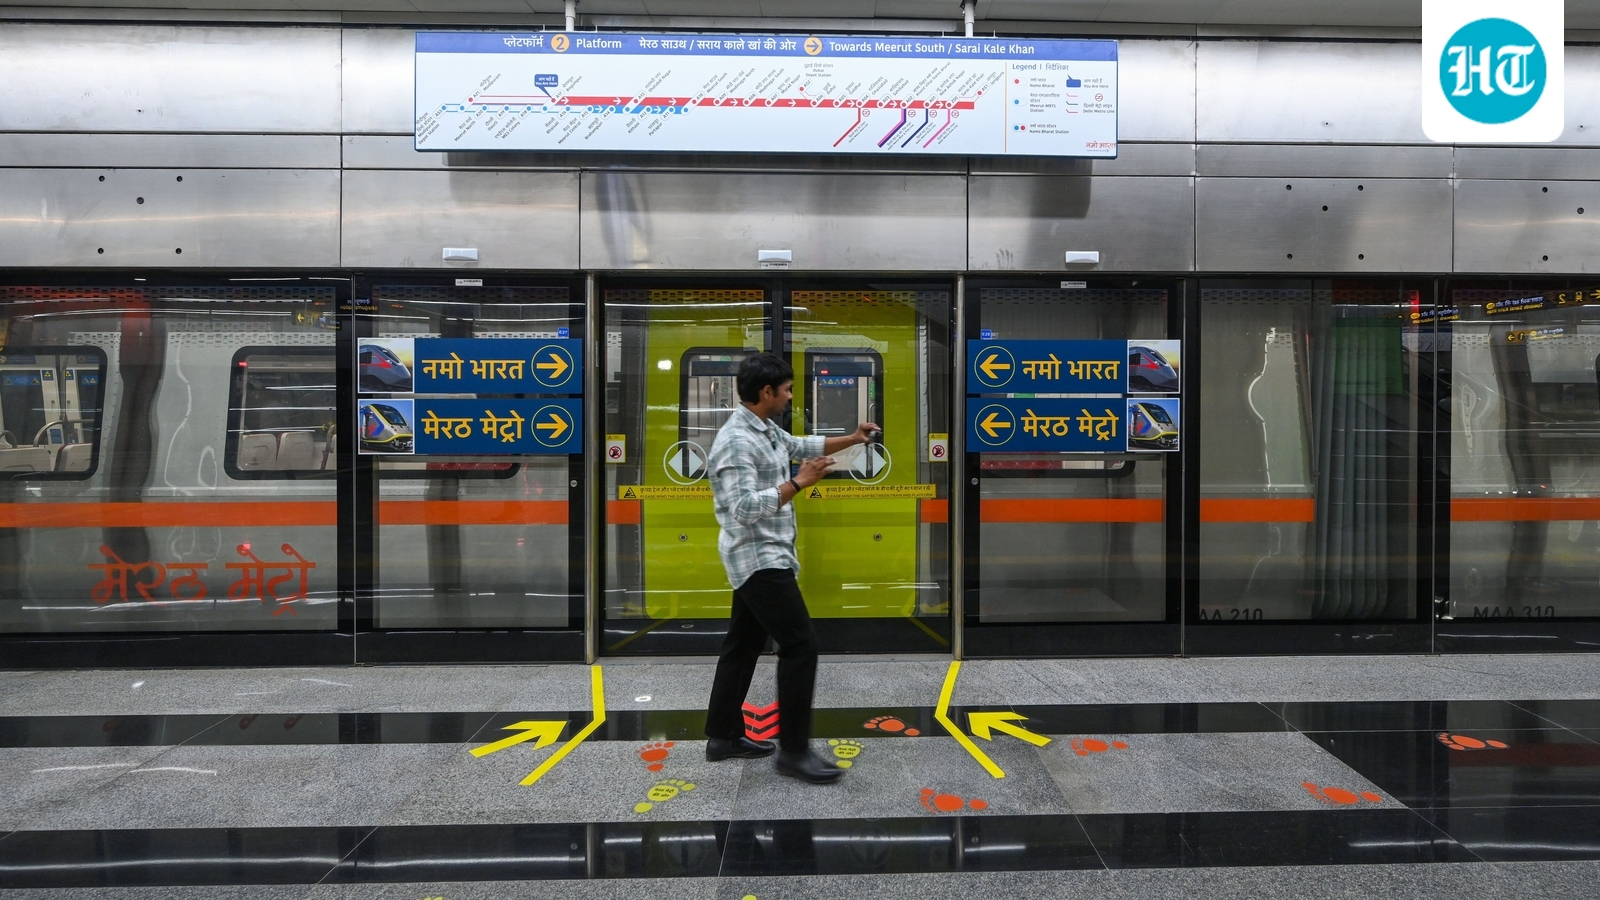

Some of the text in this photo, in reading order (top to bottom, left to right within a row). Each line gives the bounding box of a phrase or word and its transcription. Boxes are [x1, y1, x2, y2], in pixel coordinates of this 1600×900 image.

[503, 37, 543, 48] प्लेटफॉर्म
[556, 37, 622, 50] 2 Platform
[639, 37, 658, 49] मेरठ
[661, 39, 686, 50] साउथ
[697, 40, 720, 51] सराय
[723, 39, 745, 51] काले
[748, 39, 760, 51] खां
[763, 39, 777, 51] की
[779, 39, 796, 51] ओर
[830, 41, 872, 52] Towards
[875, 42, 914, 52] Meerut
[915, 42, 945, 53] South
[955, 42, 980, 53] Sarai
[984, 43, 1007, 54] Kale
[1009, 43, 1035, 54] Khan
[1013, 63, 1036, 71] Legend
[1086, 140, 1098, 149] नमो
[421, 352, 526, 380] नमो भारत
[1021, 353, 1121, 380] नमो भारत
[421, 409, 525, 443] मेरठ मेट्रो
[1020, 408, 1120, 441] मेरठ मेट्रो
[88, 542, 316, 616] मेरठ मेट्रो
[1200, 608, 1263, 621] AA 210
[1474, 605, 1555, 618] MAA 310
